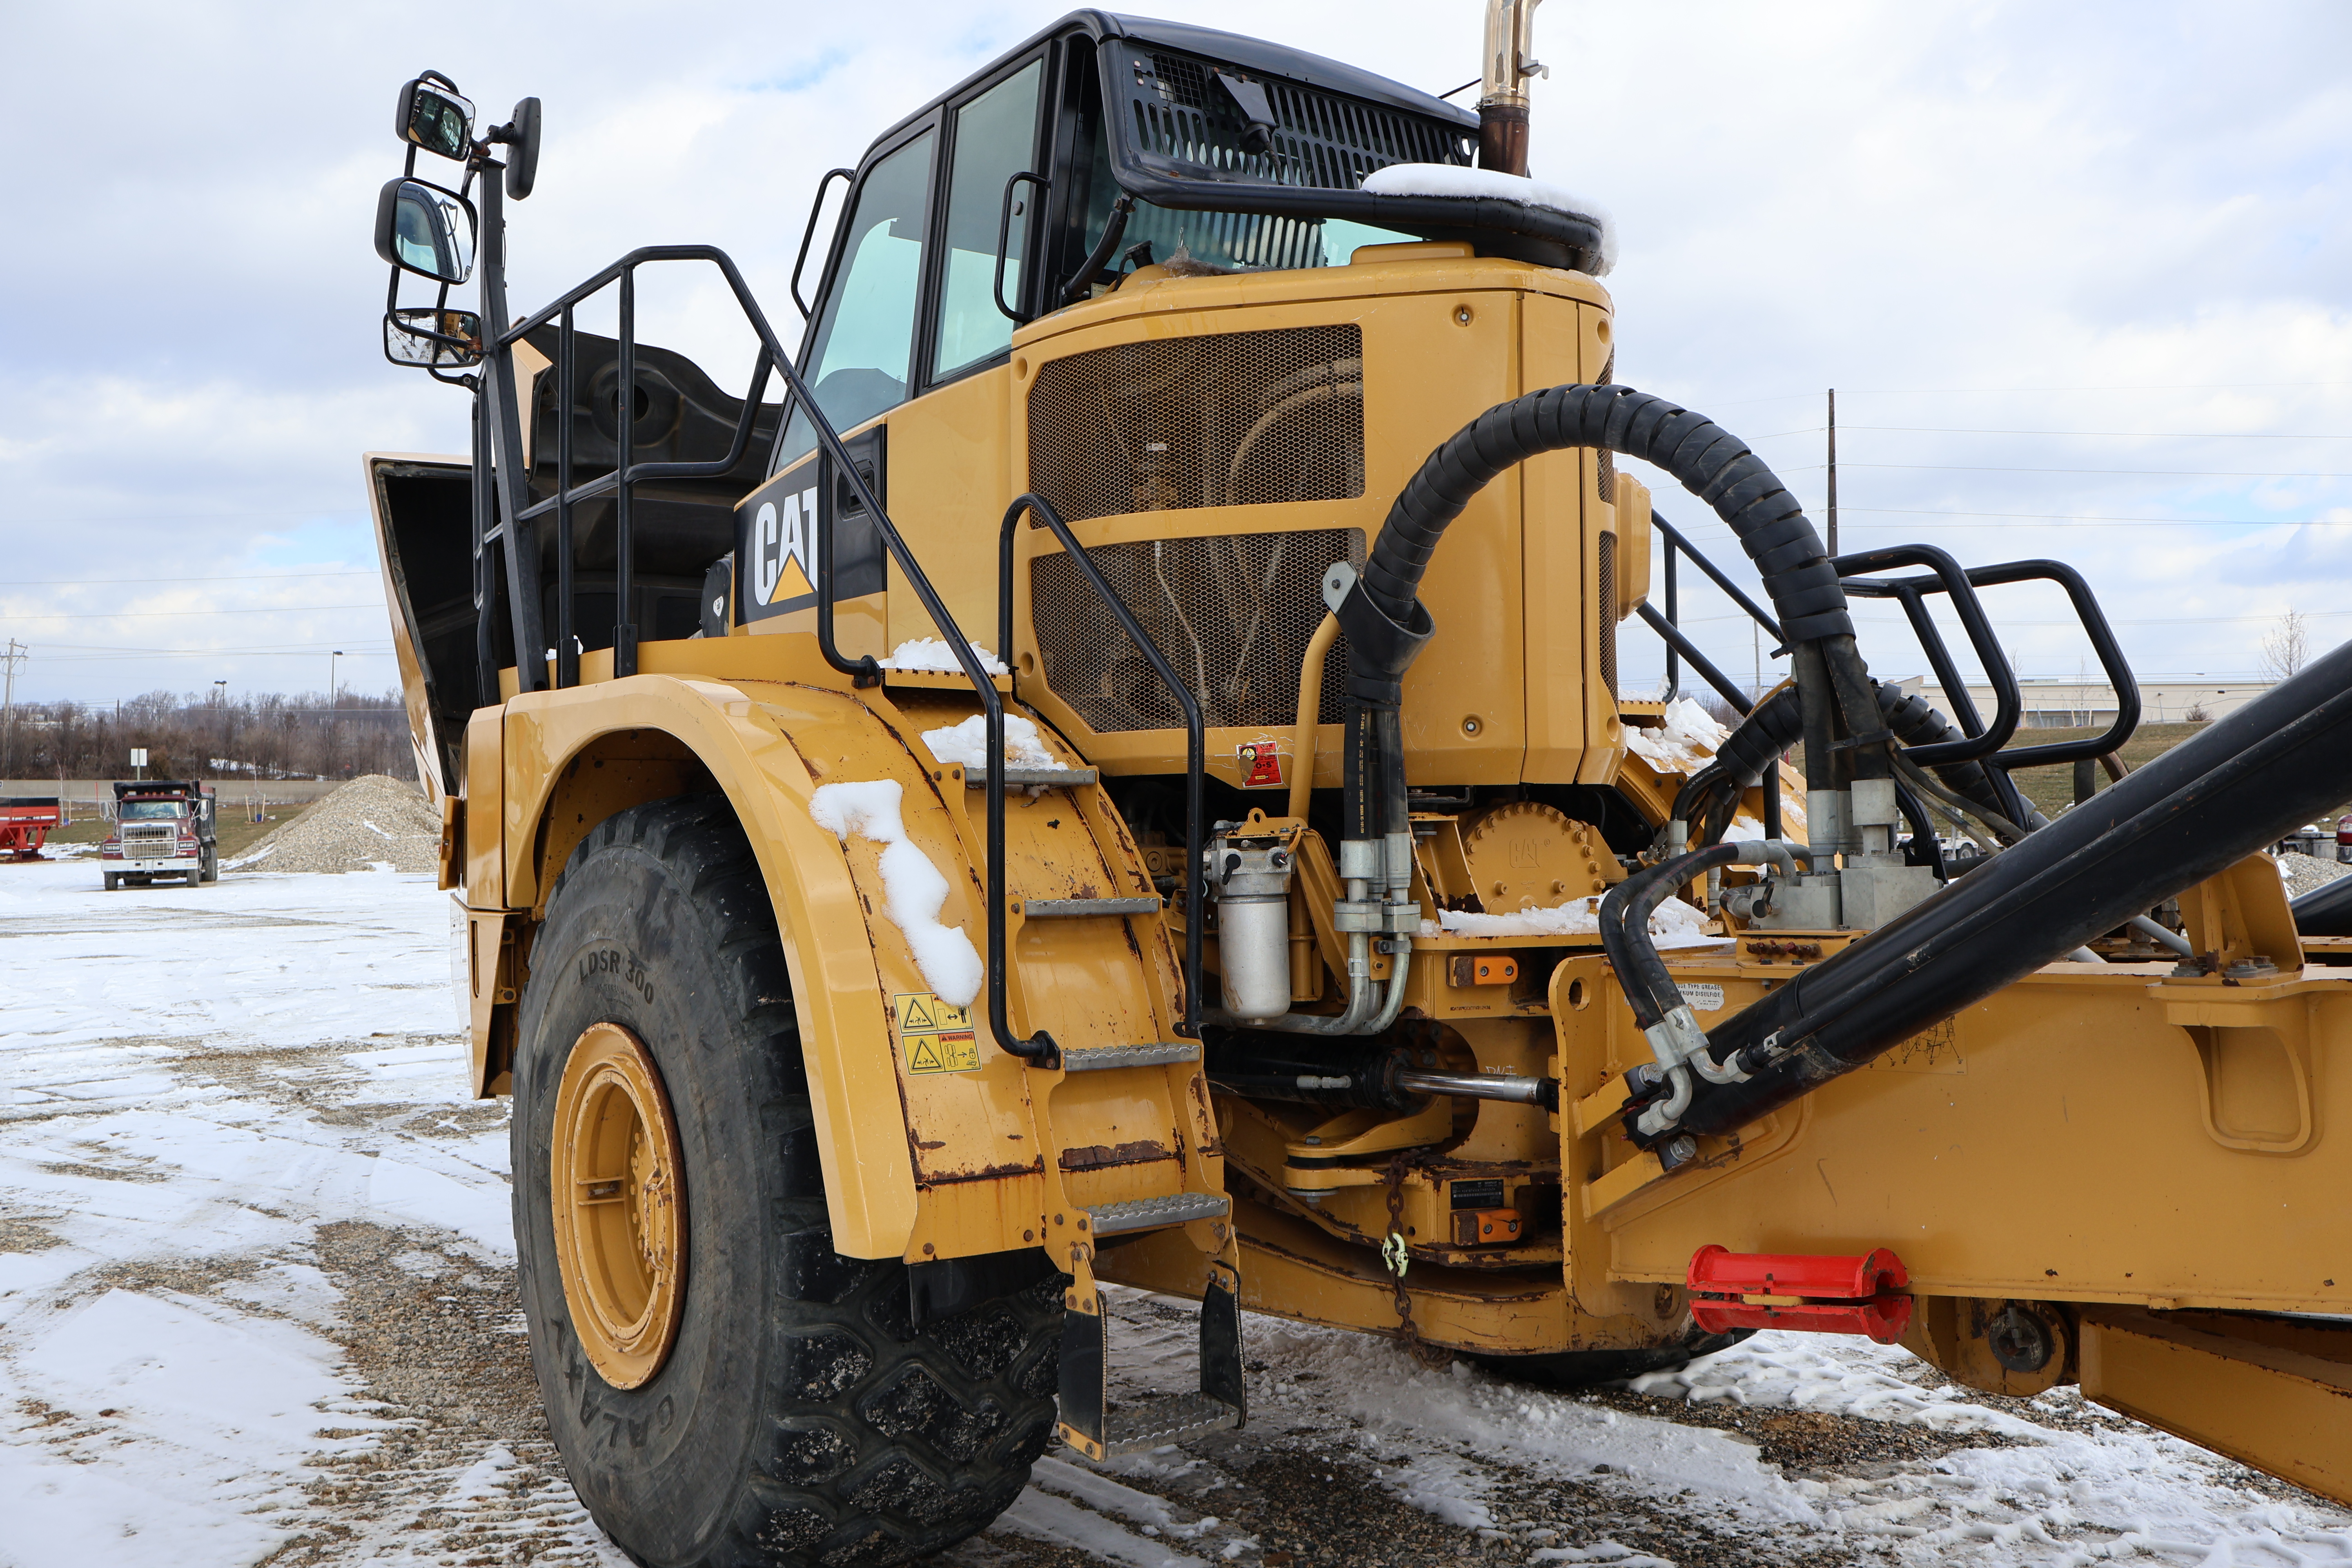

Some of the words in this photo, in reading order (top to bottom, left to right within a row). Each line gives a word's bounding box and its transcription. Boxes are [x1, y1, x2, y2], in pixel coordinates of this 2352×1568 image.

[755, 486, 818, 606] CAT
[579, 949, 621, 985] LDSR
[625, 960, 654, 1005] 300
